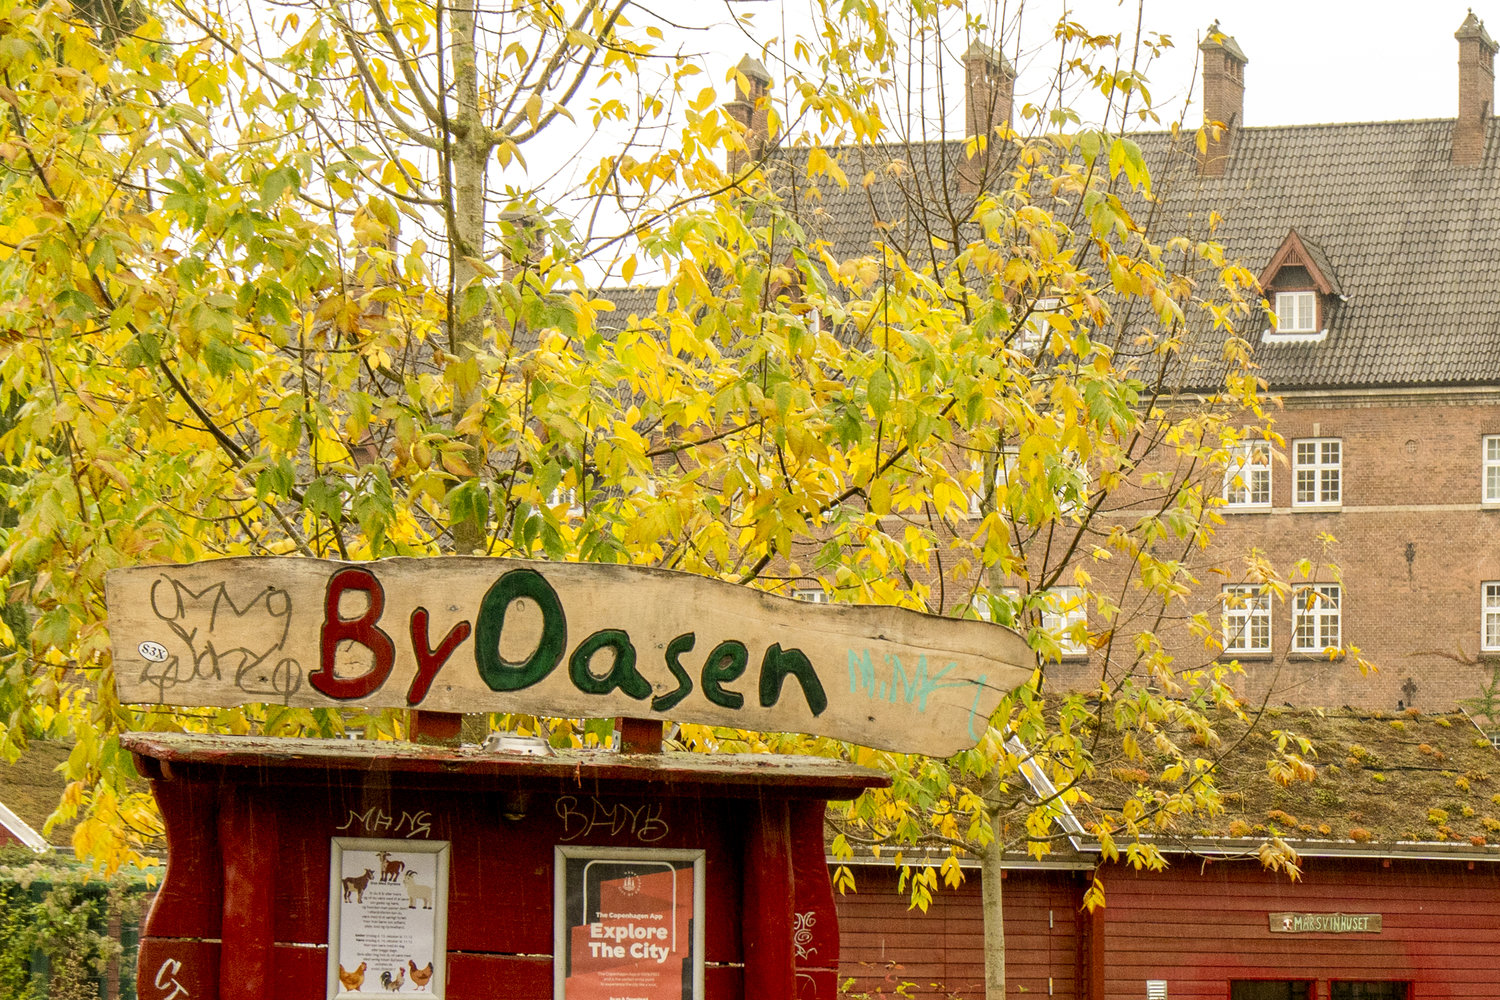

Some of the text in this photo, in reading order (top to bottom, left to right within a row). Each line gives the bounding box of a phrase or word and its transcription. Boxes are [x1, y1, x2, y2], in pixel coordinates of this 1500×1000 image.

[141, 644, 167, 659] S3X
[308, 567, 827, 717] ByOasen
[608, 912, 648, 920] Copenhagen
[590, 922, 668, 943] Explore
[588, 942, 670, 964] The City
